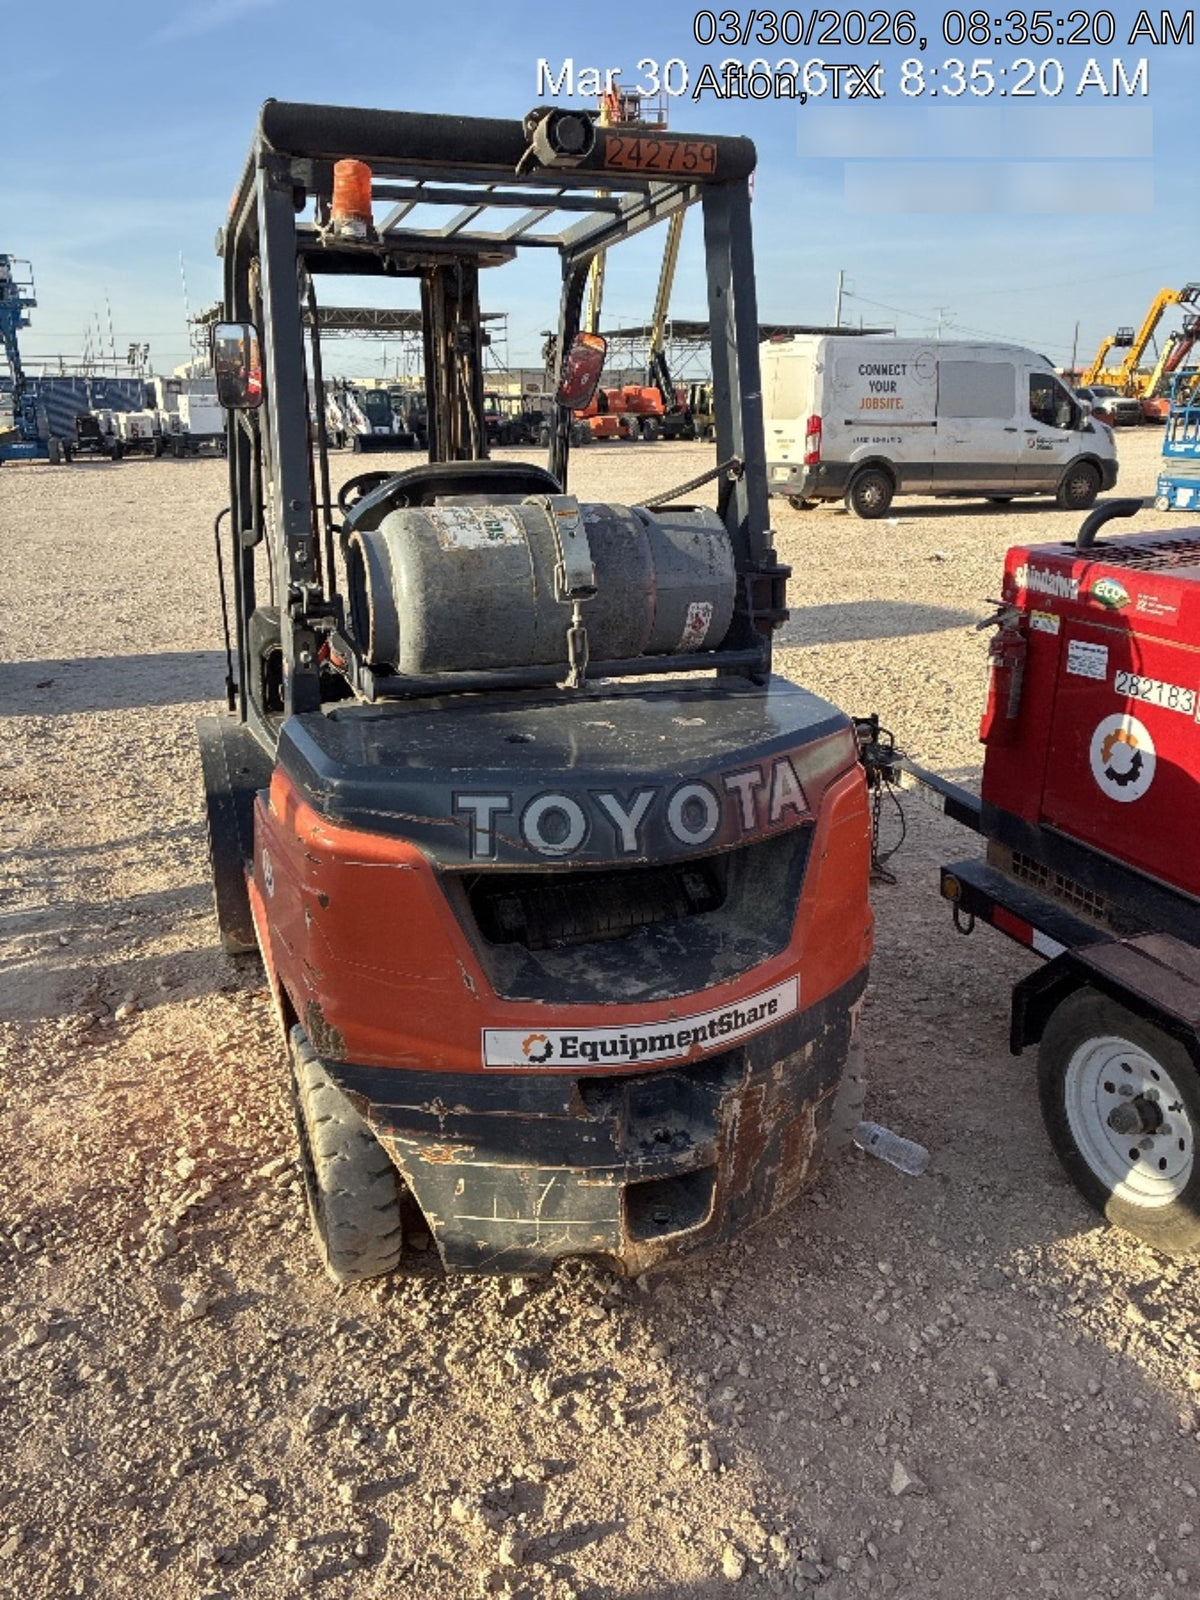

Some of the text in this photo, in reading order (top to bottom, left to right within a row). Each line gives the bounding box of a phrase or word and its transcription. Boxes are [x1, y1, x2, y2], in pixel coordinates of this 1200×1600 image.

[607, 138, 716, 172] 242759
[858, 363, 908, 376] CONNECT
[869, 380, 897, 393] YOUR
[859, 397, 904, 410] JOBSITE.
[1116, 671, 1195, 712] 282183
[453, 756, 811, 859] TOYOTA
[559, 998, 779, 1063] EquipmentShare
